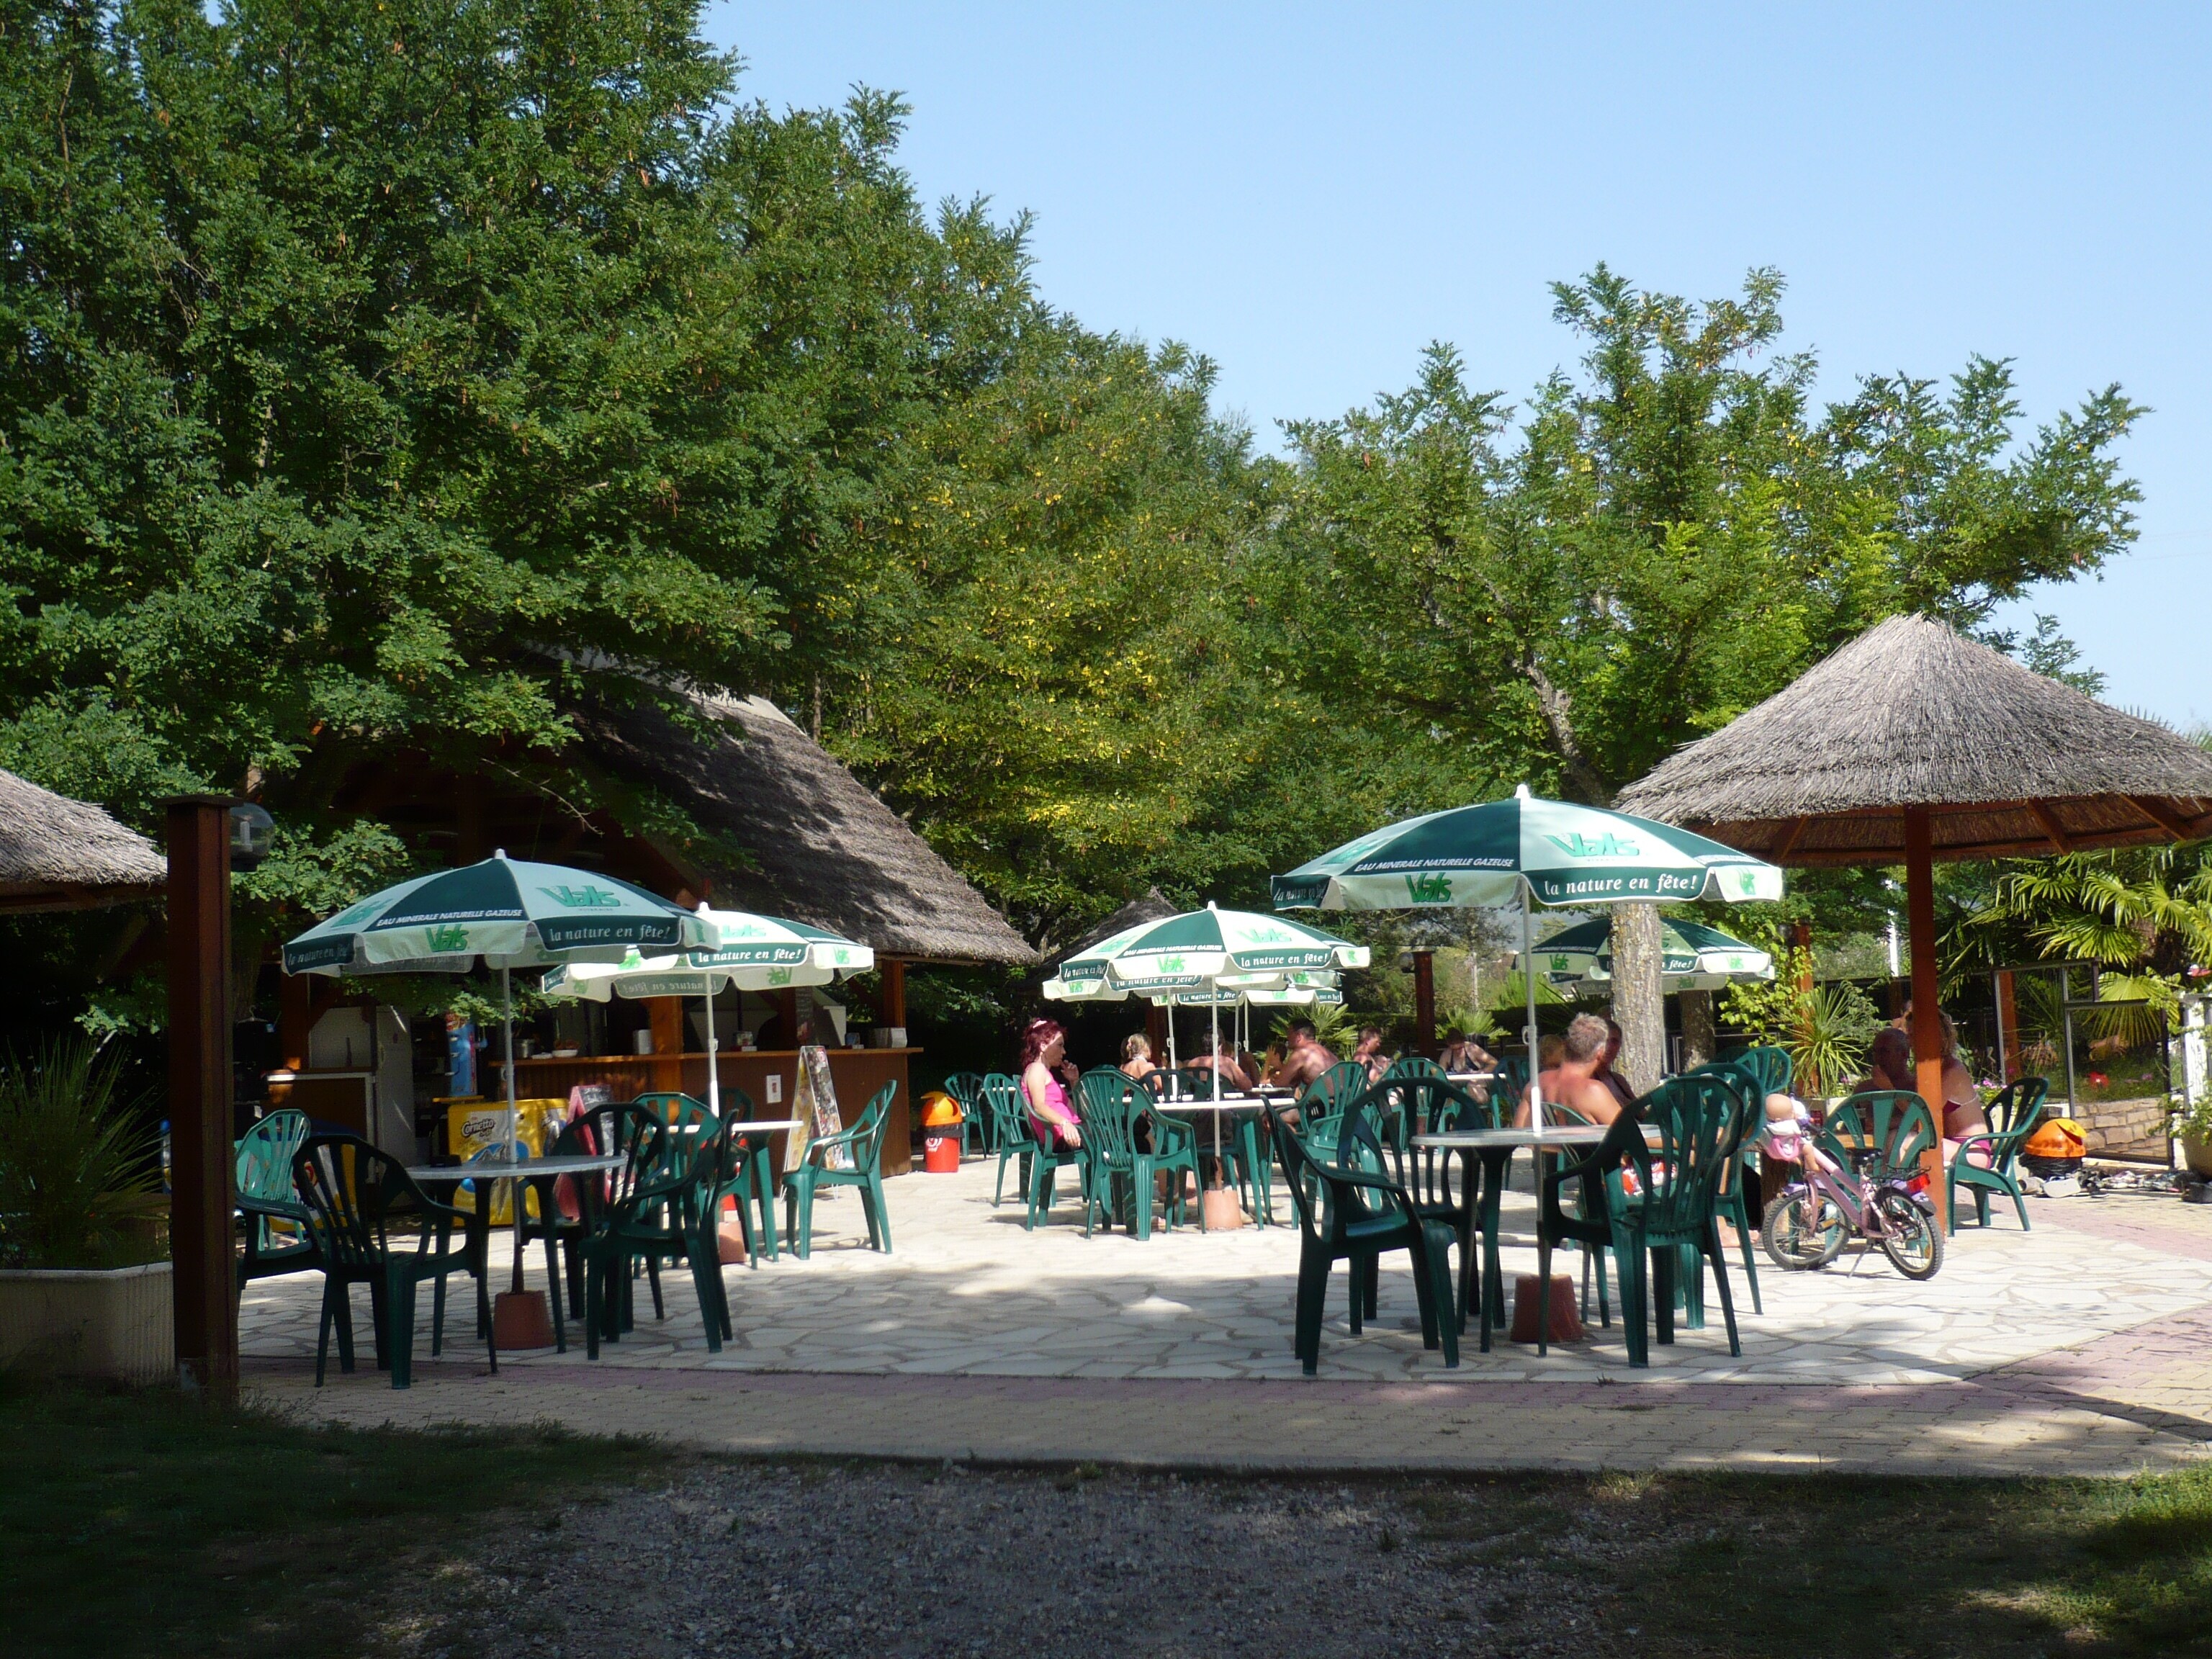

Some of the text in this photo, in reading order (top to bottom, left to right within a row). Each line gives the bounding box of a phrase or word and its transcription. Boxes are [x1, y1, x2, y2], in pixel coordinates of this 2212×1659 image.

[1542, 832, 1640, 857] Vals
[1354, 858, 1514, 872] EAU MINERALE NATURELLE GAZEUSE
[1405, 872, 1452, 903] Vals
[1545, 874, 1697, 895] la nature en fête!
[536, 885, 621, 907] Vals
[376, 909, 523, 927] EAU MINERALE NATURELLE GAZEUSE
[425, 924, 469, 952] Vals
[549, 925, 670, 942] la nature en fête!
[698, 948, 802, 963] la nature en fête!
[1241, 957, 1251, 967] la
[1253, 956, 1285, 966] nature
[1303, 953, 1328, 964] fête!
[1668, 959, 1692, 970] fête!
[462, 1118, 495, 1138] Cornetto
